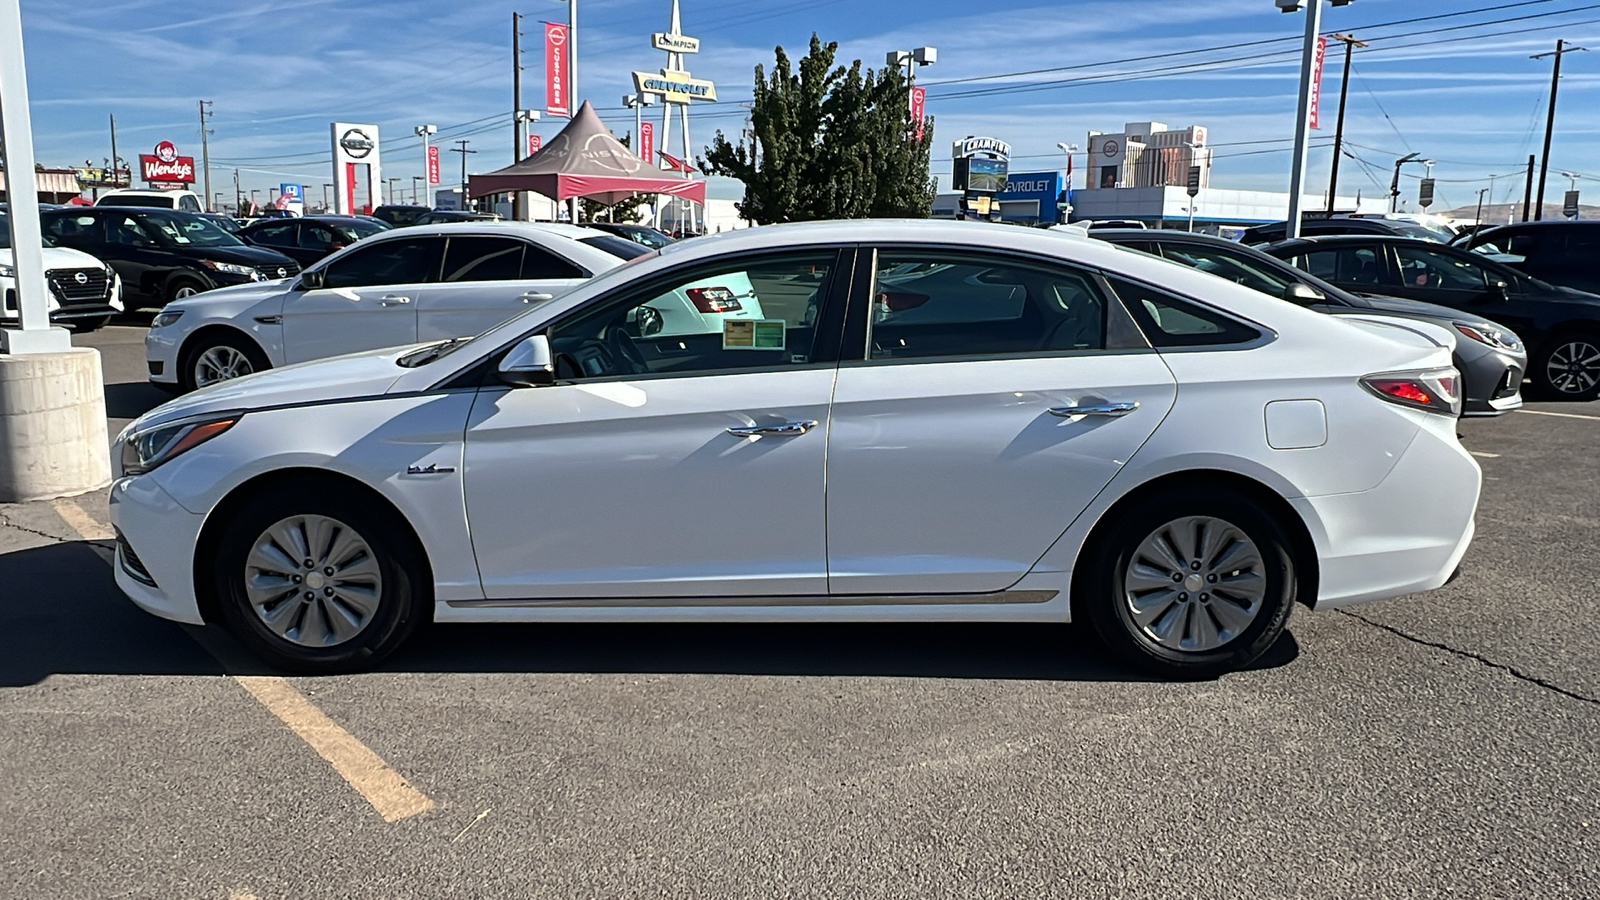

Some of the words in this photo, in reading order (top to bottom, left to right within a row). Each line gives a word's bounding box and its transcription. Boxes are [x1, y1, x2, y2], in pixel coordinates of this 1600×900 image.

[553, 47, 561, 105] CUSTOMER
[643, 79, 709, 96] CHEVROLET
[1311, 61, 1320, 124] NISSAN
[580, 150, 637, 161] NISSAN
[965, 139, 1010, 155] CHAMPION
[145, 160, 192, 179] Wendy's
[1006, 180, 1050, 193] EVROLET
